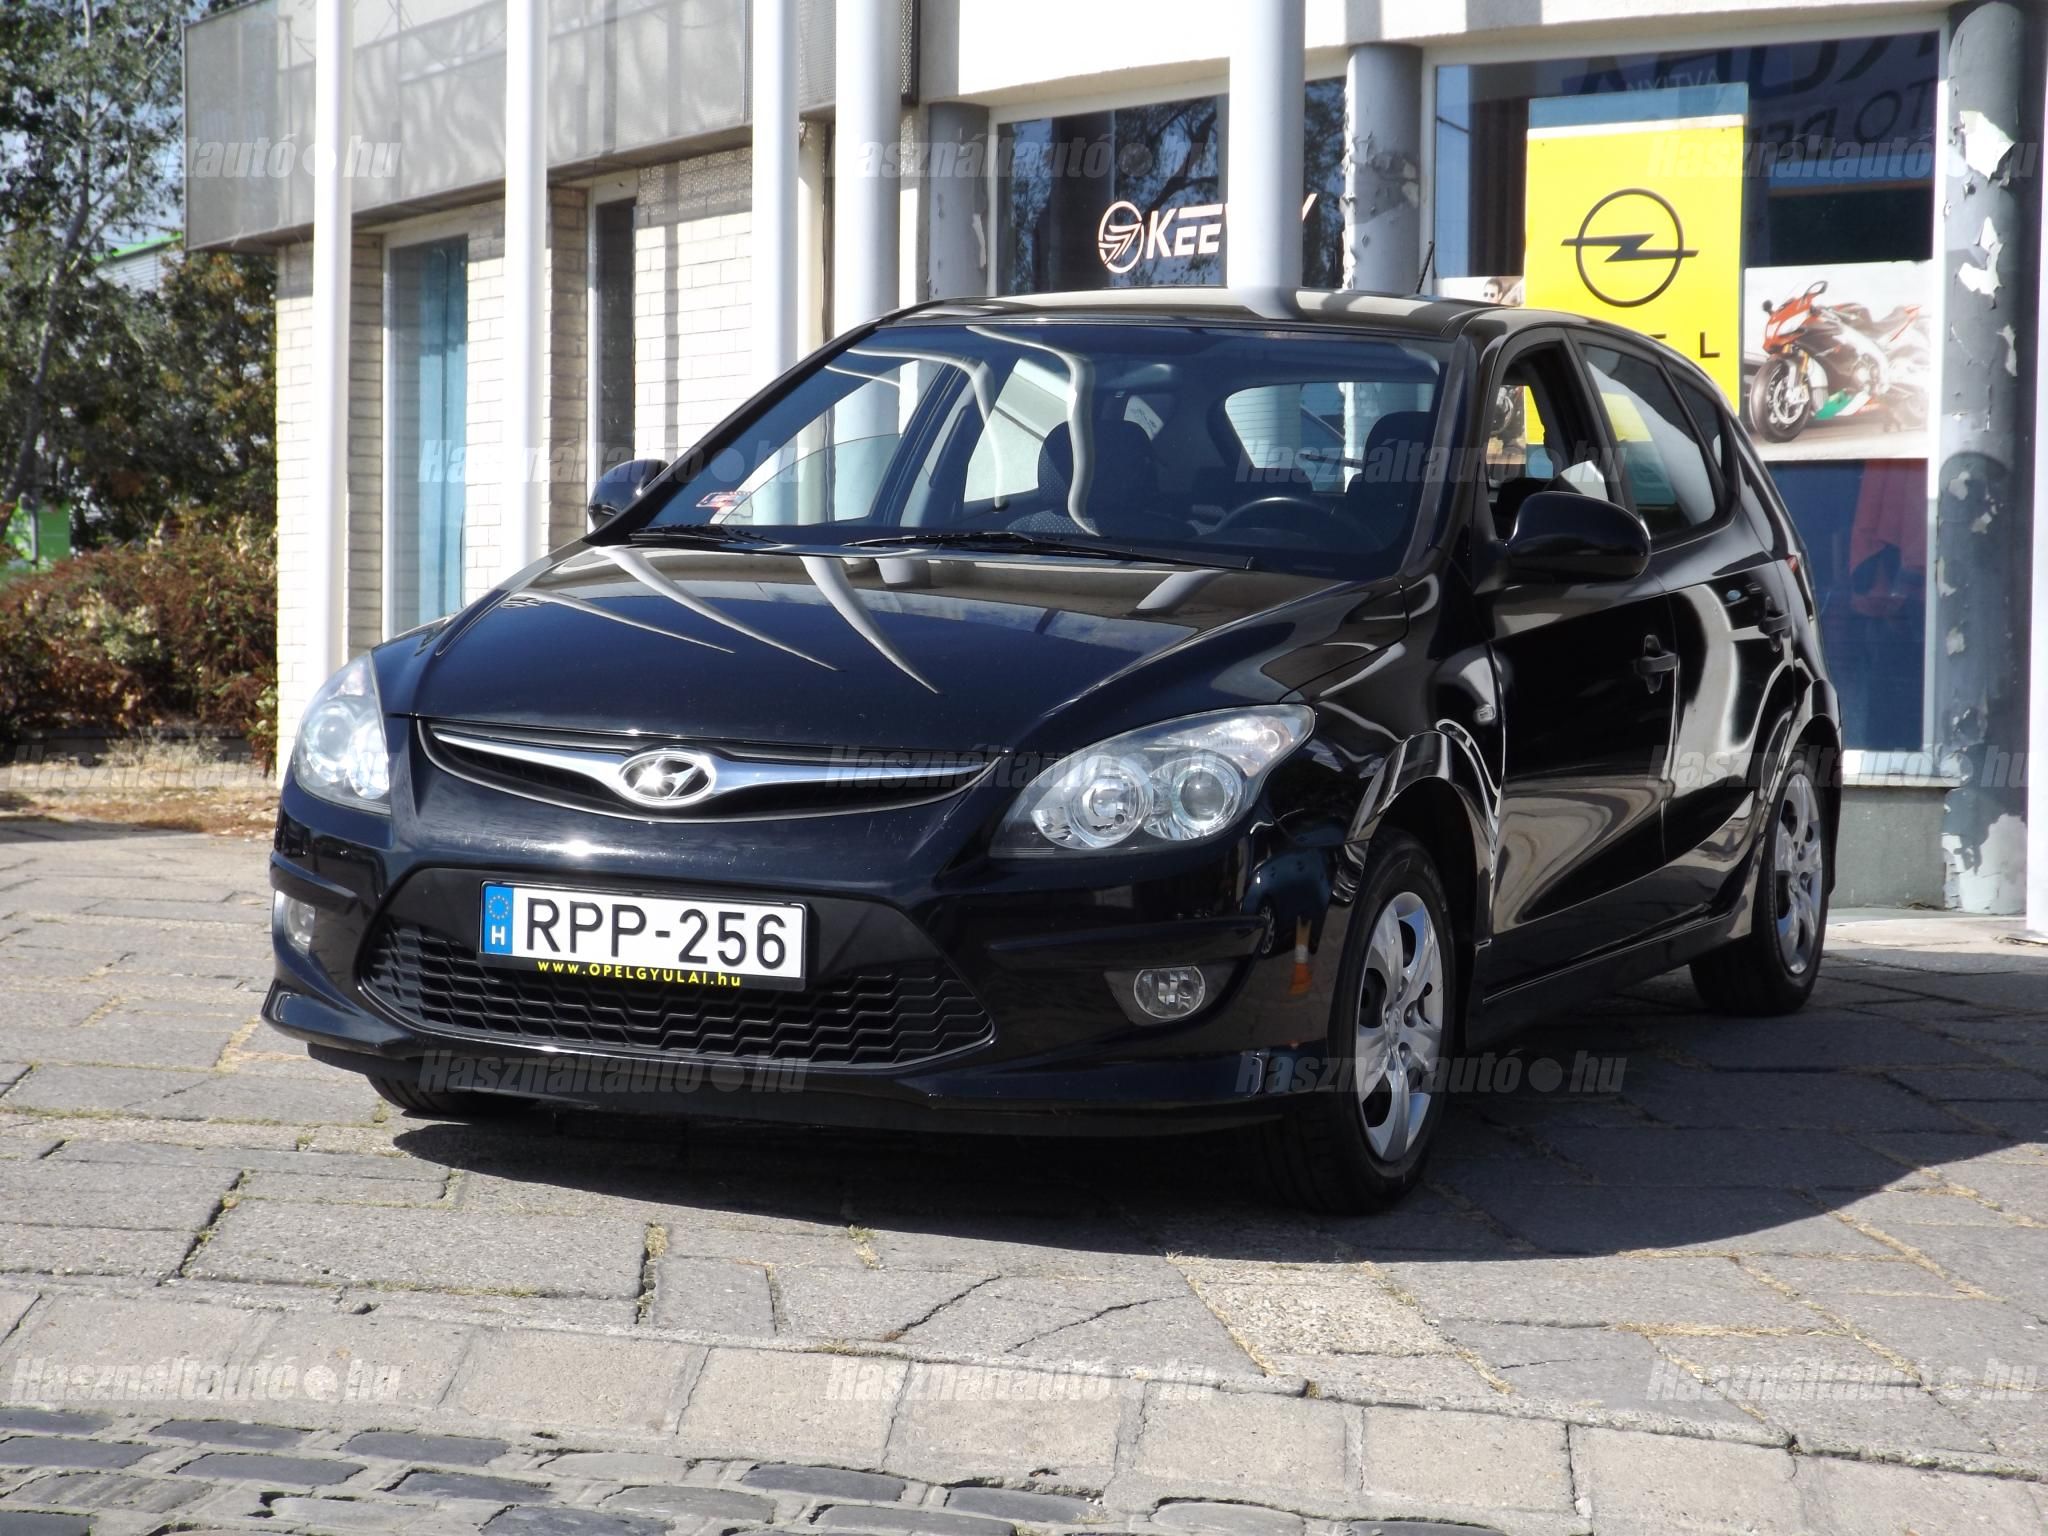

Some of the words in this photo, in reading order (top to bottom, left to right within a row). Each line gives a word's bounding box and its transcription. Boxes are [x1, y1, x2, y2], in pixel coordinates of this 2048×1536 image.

[491, 925, 506, 946] H
[526, 897, 787, 969] RPP-256
[537, 961, 742, 986] www.OPELGYULAI.hu
